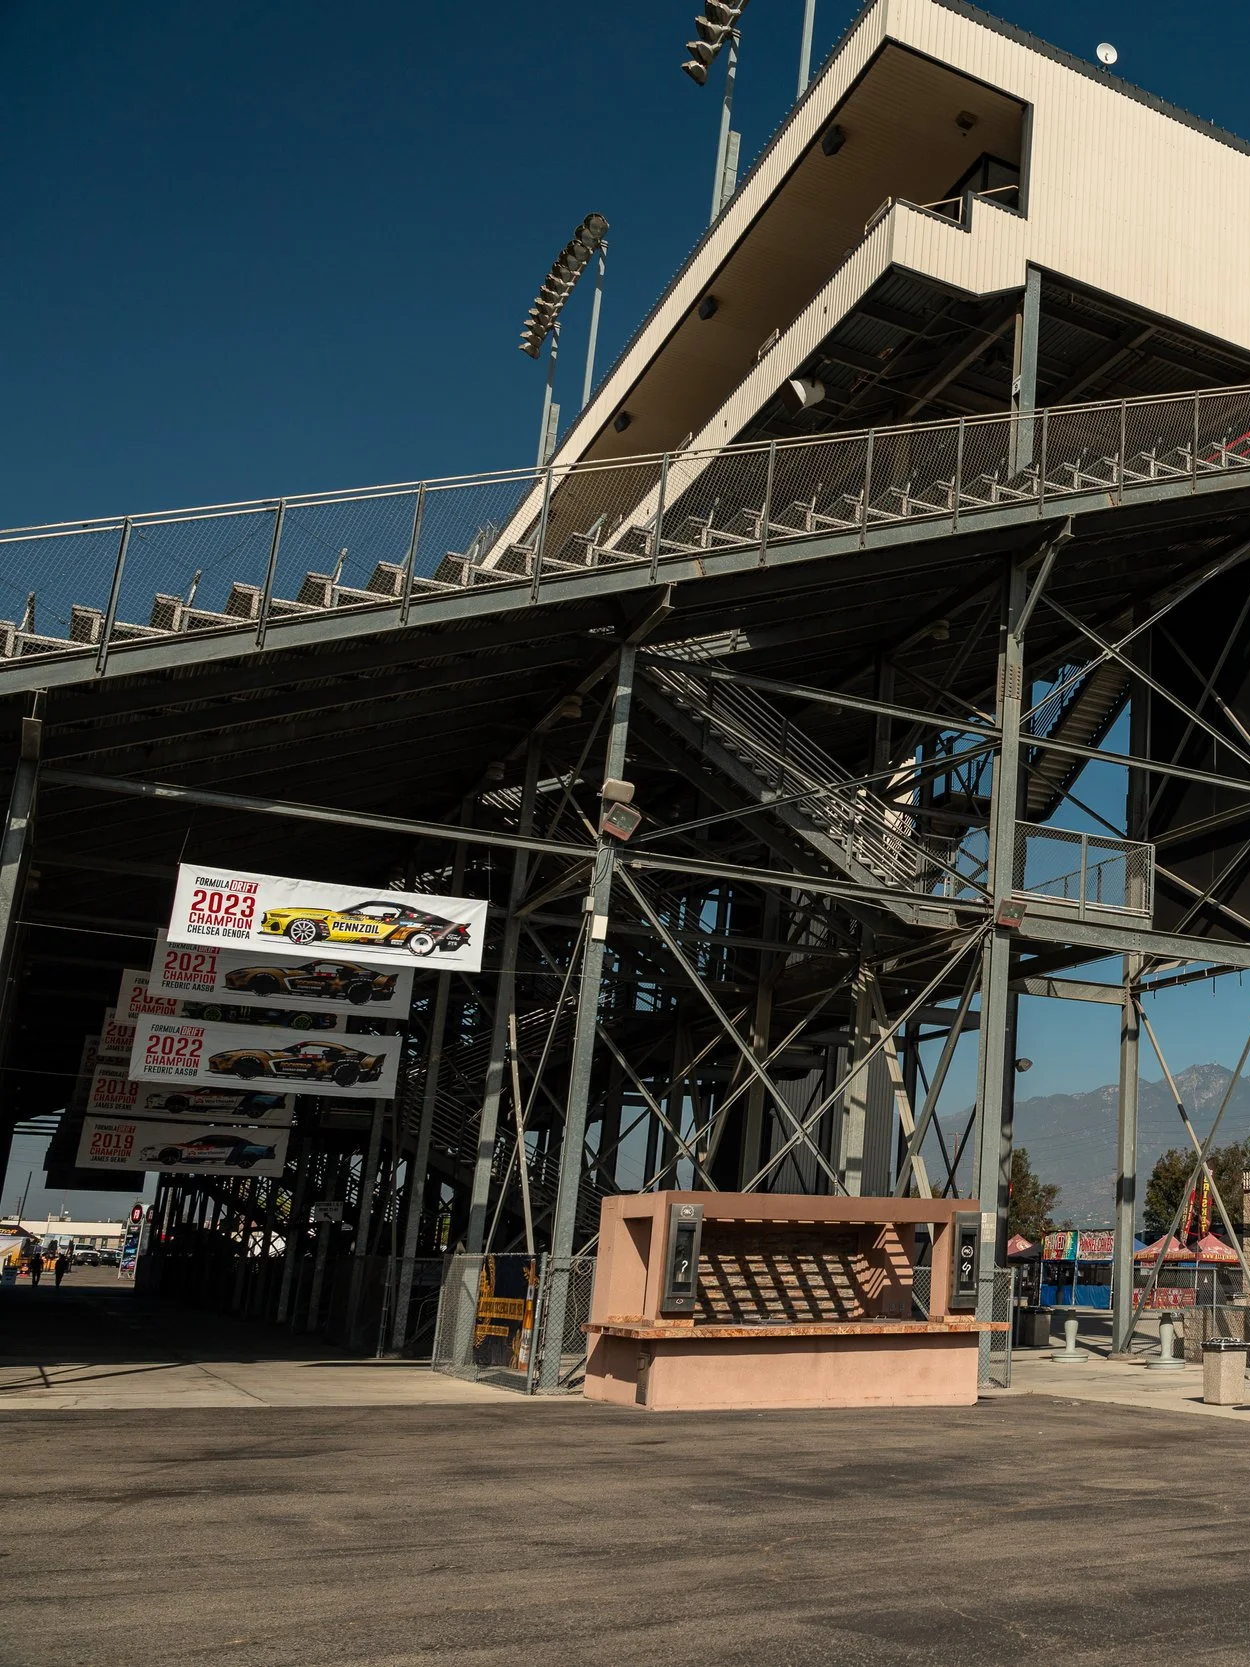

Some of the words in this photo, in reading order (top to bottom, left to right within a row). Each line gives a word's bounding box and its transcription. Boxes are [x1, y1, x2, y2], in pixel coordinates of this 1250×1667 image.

[195, 877, 230, 889] FORMULA
[231, 880, 259, 893] DRIFT
[191, 890, 256, 918] 2023
[188, 911, 253, 930] CHAMPION
[332, 921, 379, 934] PENNZOIL
[187, 924, 220, 936] CHELSEA
[222, 928, 250, 939] DENOFA
[168, 942, 198, 951] FORMULA
[164, 951, 217, 974] 2021
[163, 970, 217, 985] CHAMPION
[161, 980, 190, 990] FREDRIC
[129, 1003, 176, 1016] CHAMPION
[106, 1021, 136, 1038] 201
[151, 1024, 181, 1034] FORMULA
[182, 1026, 205, 1037] DRIFT
[104, 1036, 134, 1046] CHAMP
[146, 1035, 203, 1058] 2022
[145, 1055, 200, 1069] CHAMPION
[143, 1065, 173, 1075] FREDRIC
[95, 1079, 139, 1096] 2018
[93, 1094, 137, 1105] CHAMPION
[91, 1132, 135, 1149] 2019
[89, 1148, 132, 1157] CHAMPION
